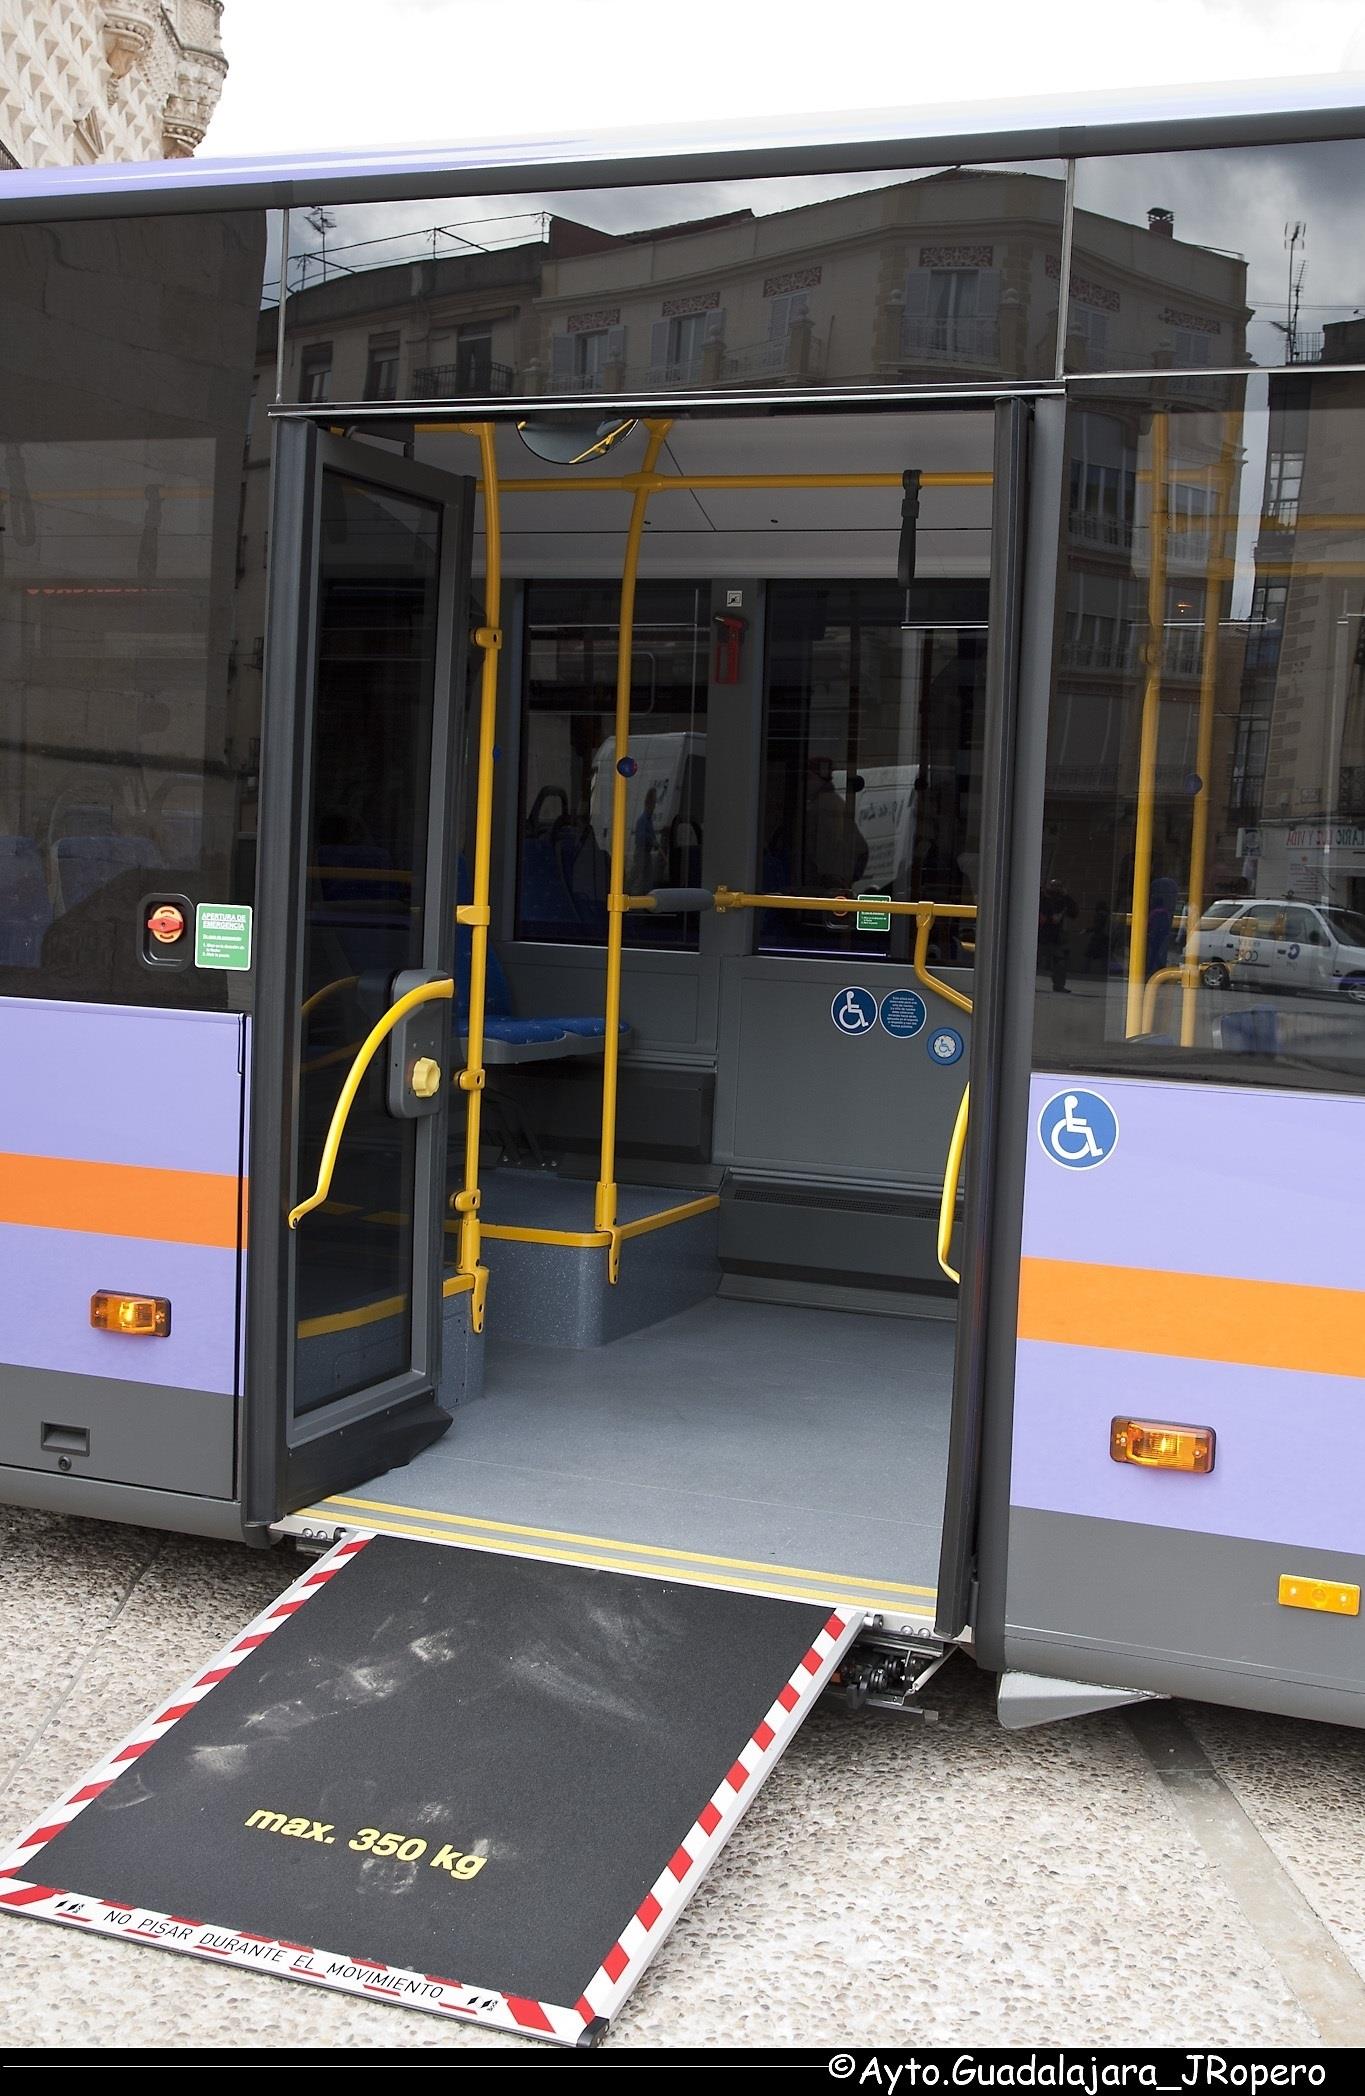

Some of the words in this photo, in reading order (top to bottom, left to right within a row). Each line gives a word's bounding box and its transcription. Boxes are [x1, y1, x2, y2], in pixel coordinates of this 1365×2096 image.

[202, 912, 236, 922] APERTURA
[237, 914, 246, 923] DE
[244, 1809, 336, 1844] max.
[348, 1828, 428, 1861] 350
[429, 1844, 488, 1880] kg
[103, 1910, 132, 1925] NO
[137, 1918, 193, 1940] PISAR
[199, 1932, 288, 1962] DURANTE
[293, 1954, 315, 1970] EL
[326, 1962, 444, 1999] MOVIMIENTO
